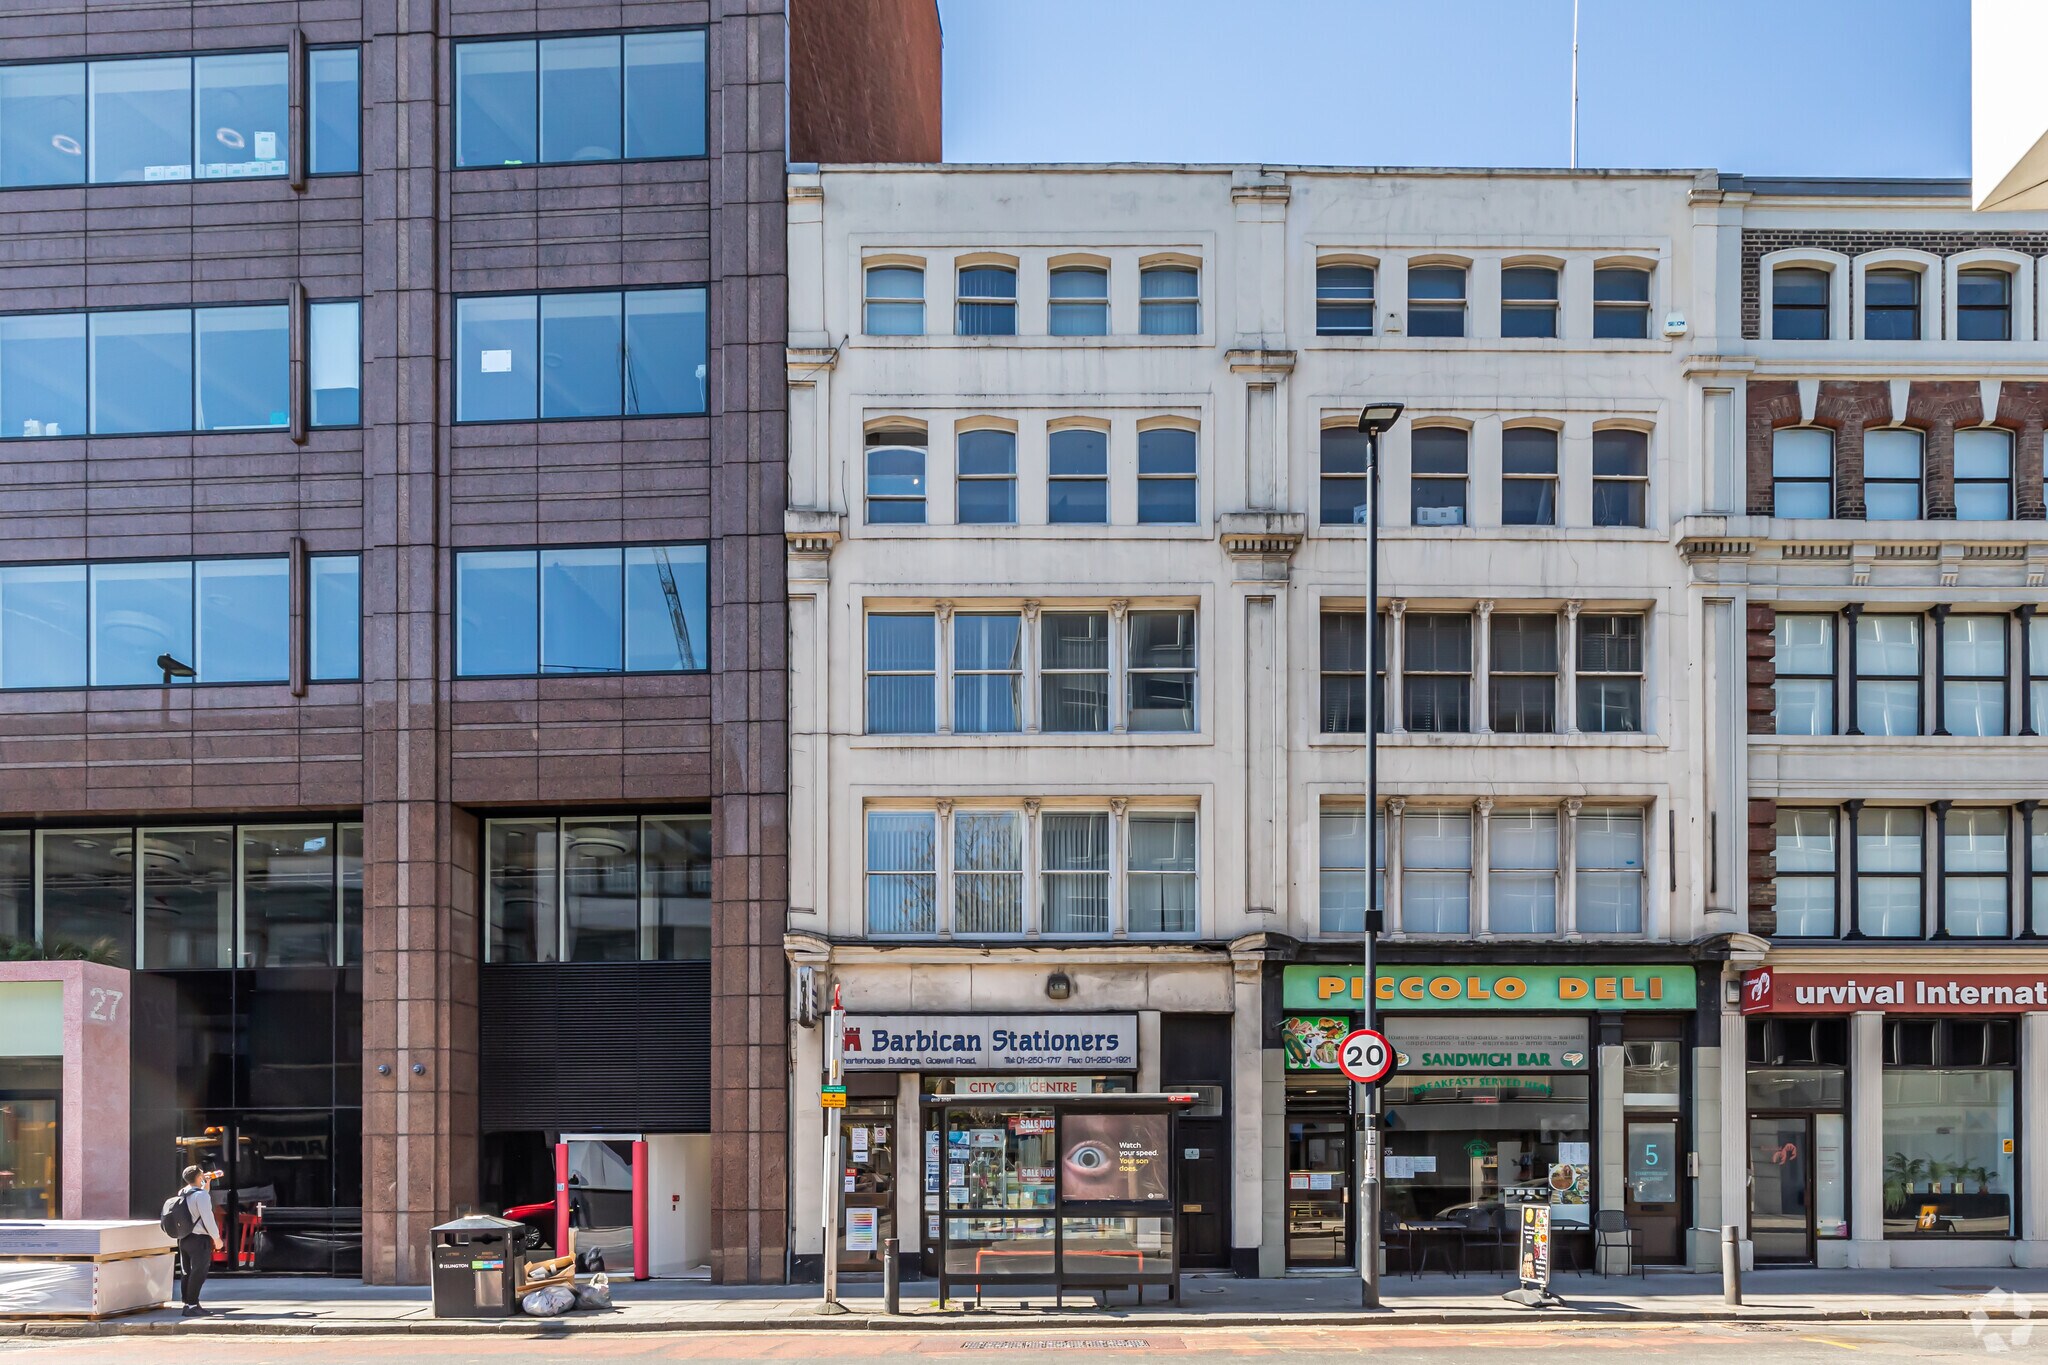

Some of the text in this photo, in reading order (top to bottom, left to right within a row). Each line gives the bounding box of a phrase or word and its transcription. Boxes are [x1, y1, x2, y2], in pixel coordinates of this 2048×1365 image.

[1318, 976, 1663, 1000] PICCOLO DELI
[1916, 980, 2048, 1005] Internat
[89, 987, 124, 1022] 27
[871, 1029, 1119, 1052] Barbican Stationers
[844, 1056, 886, 1065] harterhouse
[926, 1056, 955, 1065] Goswell
[1067, 1056, 1083, 1065] Fax:
[1346, 1044, 1384, 1067] 20
[1422, 1052, 1552, 1067] SANDWICH BAR
[1413, 1077, 1476, 1095] BREAKFAST
[1479, 1077, 1522, 1087] SERVED
[1020, 1119, 1039, 1129] SALE
[1119, 1149, 1159, 1157] your speed.
[1645, 1144, 1659, 1166] 5
[1021, 1168, 1039, 1177] SALE
